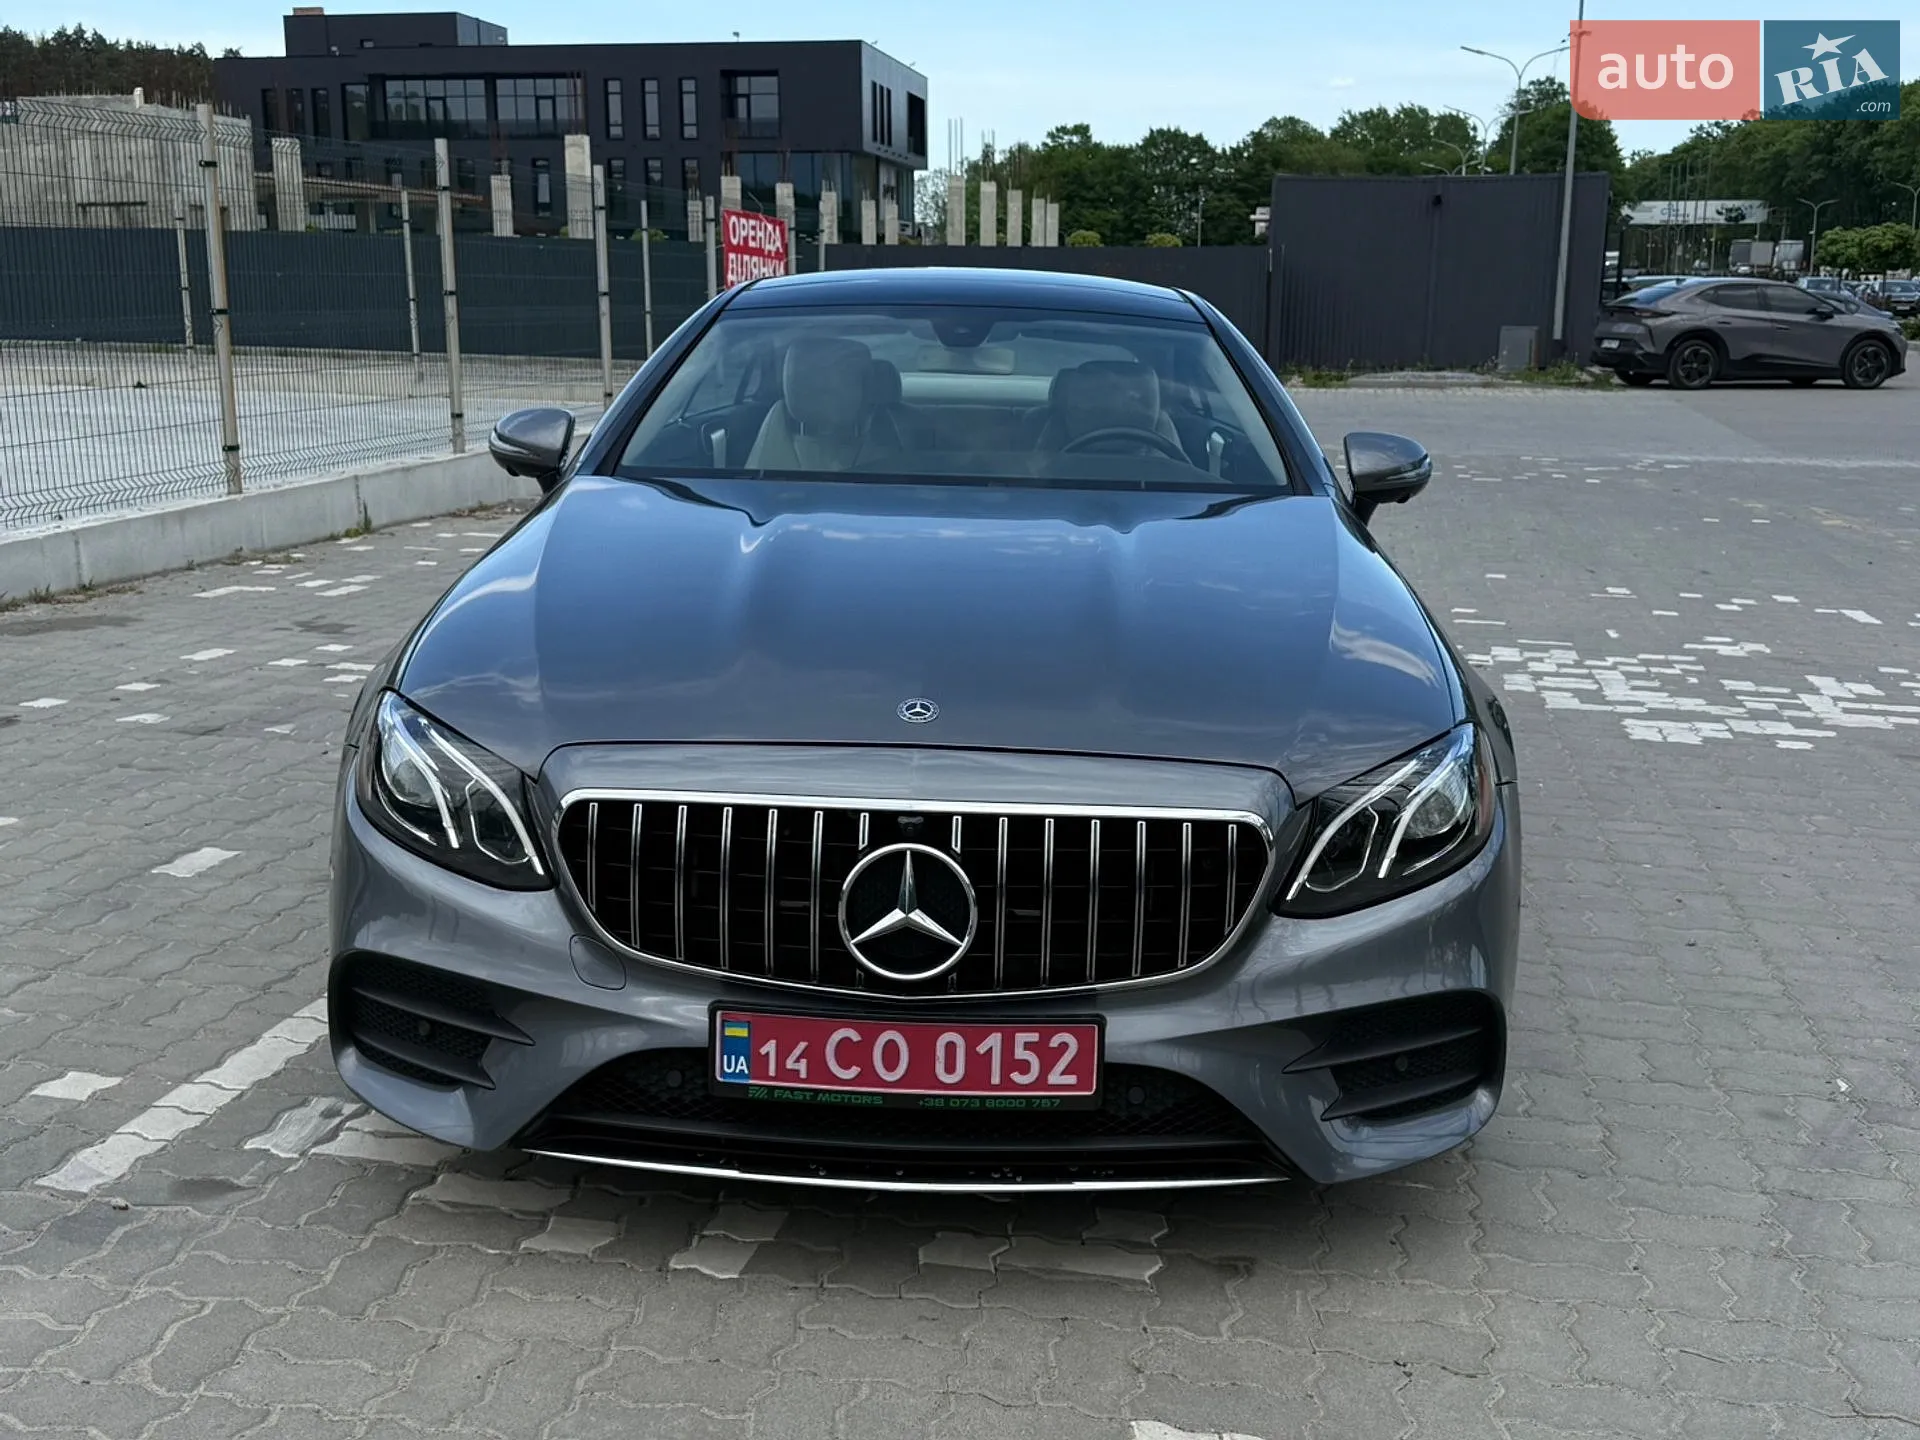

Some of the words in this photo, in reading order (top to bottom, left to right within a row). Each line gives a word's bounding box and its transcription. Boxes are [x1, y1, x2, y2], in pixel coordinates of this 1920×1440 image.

[729, 215, 783, 256] ОРЕНДА
[723, 1054, 749, 1074] UA
[759, 1040, 808, 1079] 14
[825, 1027, 909, 1082] CO
[935, 1032, 1078, 1085] 0152
[774, 1089, 814, 1101] FAST
[817, 1092, 883, 1105] MOTORS
[917, 1098, 946, 1108] +38
[949, 1098, 980, 1108] 073
[1031, 1098, 1061, 1108] 757
